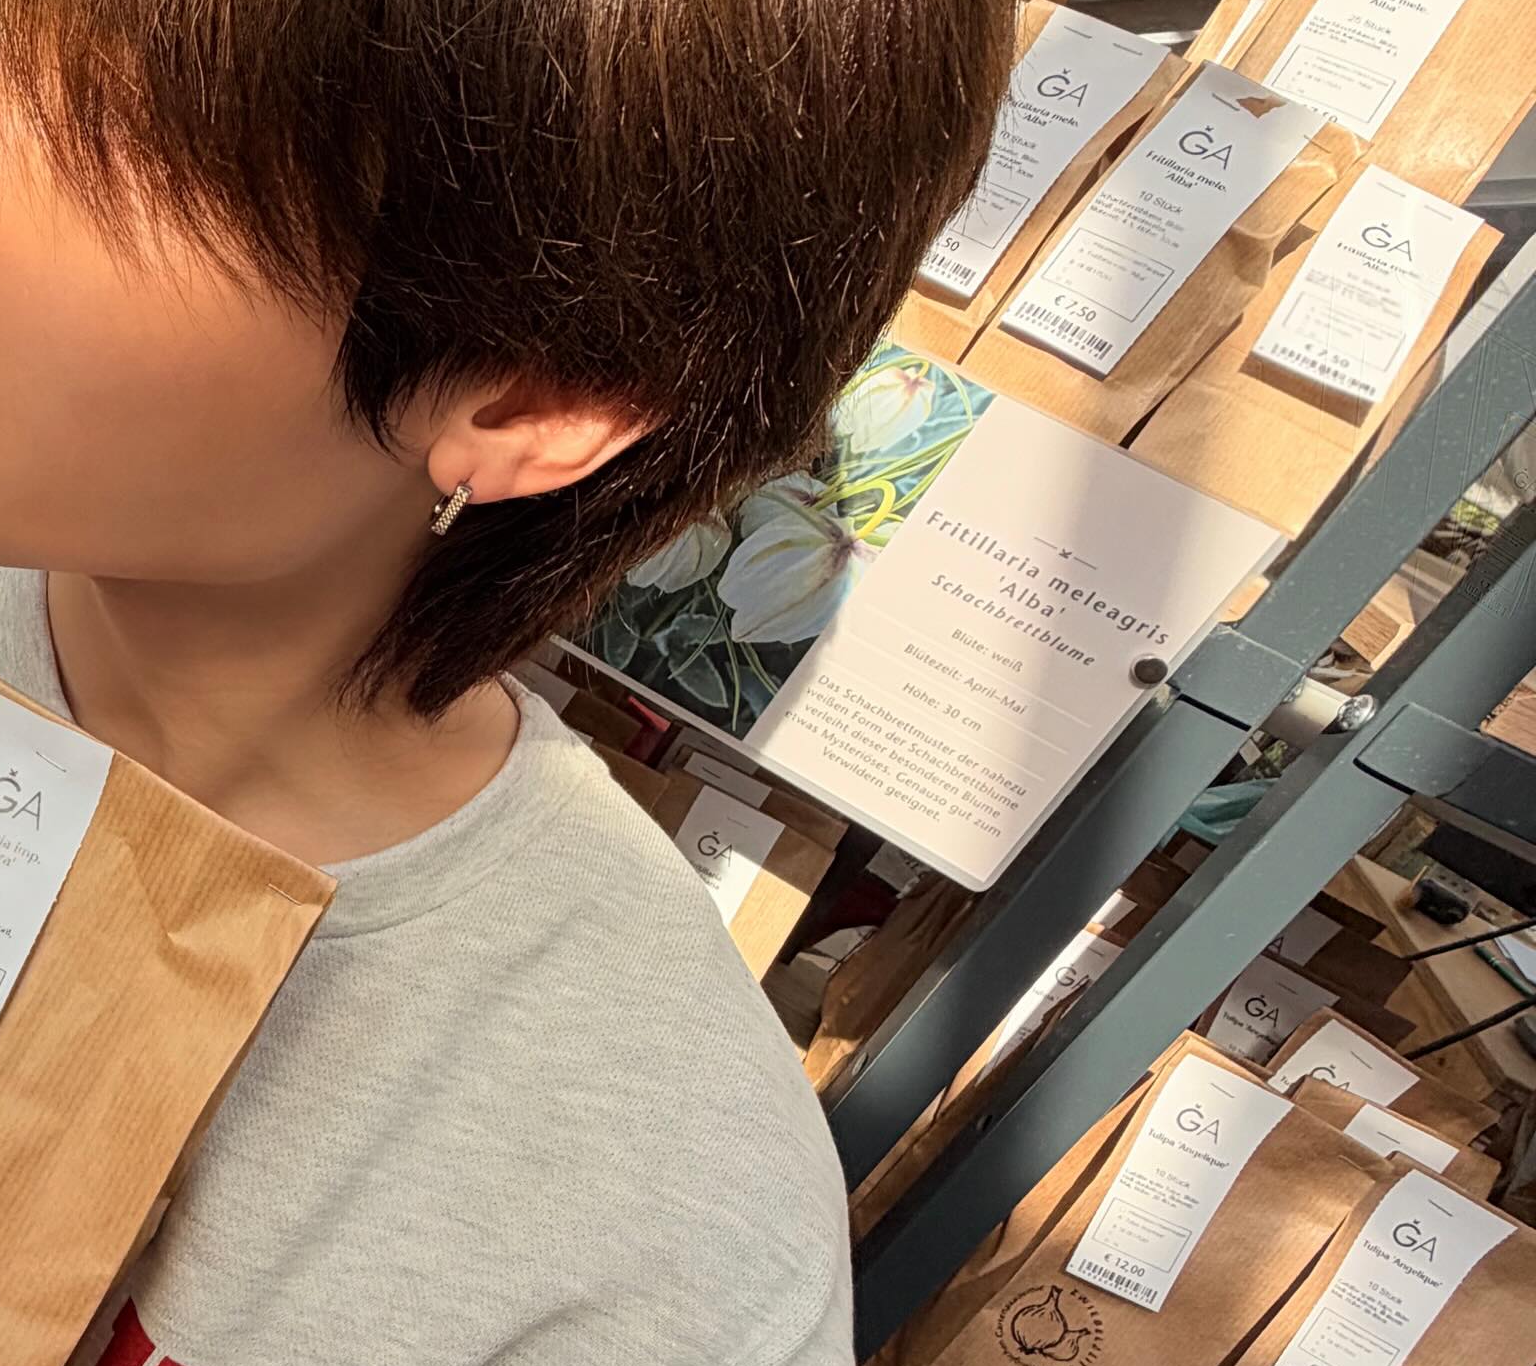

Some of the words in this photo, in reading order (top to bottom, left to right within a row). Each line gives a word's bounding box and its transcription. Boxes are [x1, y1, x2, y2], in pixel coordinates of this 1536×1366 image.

[1145, 150, 1195, 179] Fritillaria
[1196, 174, 1227, 193] mele.
[1165, 171, 1198, 190] 'Alba'
[1139, 189, 1152, 201] 10
[1153, 196, 1184, 215] Stück
[1054, 294, 1066, 306] €
[1065, 299, 1097, 323] 7,50
[926, 510, 1040, 579] Fritillaria
[1048, 576, 1170, 646] meleagris
[999, 575, 1066, 619] 'Alba'
[931, 574, 1096, 667] Schachbrettblume
[903, 643, 963, 681] Blütezeit:
[952, 628, 989, 655] Blüte:
[991, 650, 1024, 673] weiß
[902, 682, 939, 709] Höhe:
[942, 704, 961, 719] 30
[962, 716, 983, 732] cm
[806, 687, 849, 716] weißen
[851, 710, 883, 735] Form
[885, 730, 907, 750] der
[907, 742, 1020, 812] Schachbrettblume
[817, 674, 841, 694] Das
[842, 688, 956, 756] Schachbrettmuster
[956, 750, 979, 770] der
[980, 765, 1028, 797] nahezu
[784, 710, 819, 734] etwas
[895, 771, 948, 806] Genauso
[949, 801, 972, 822] gut
[973, 817, 1002, 838] zum
[804, 703, 850, 734] verleiht
[850, 728, 888, 755] dieser
[889, 749, 960, 796] besonderen
[962, 790, 1002, 818] Blume
[822, 745, 885, 788] Verwildern
[885, 783, 941, 823] geeignet.
[14, 842, 41, 865] imp.
[1148, 1128, 1175, 1147] Tulipa
[1104, 1253, 1113, 1263] €
[1116, 1257, 1146, 1278] 12,00
[1363, 1239, 1391, 1260] Tulipa
